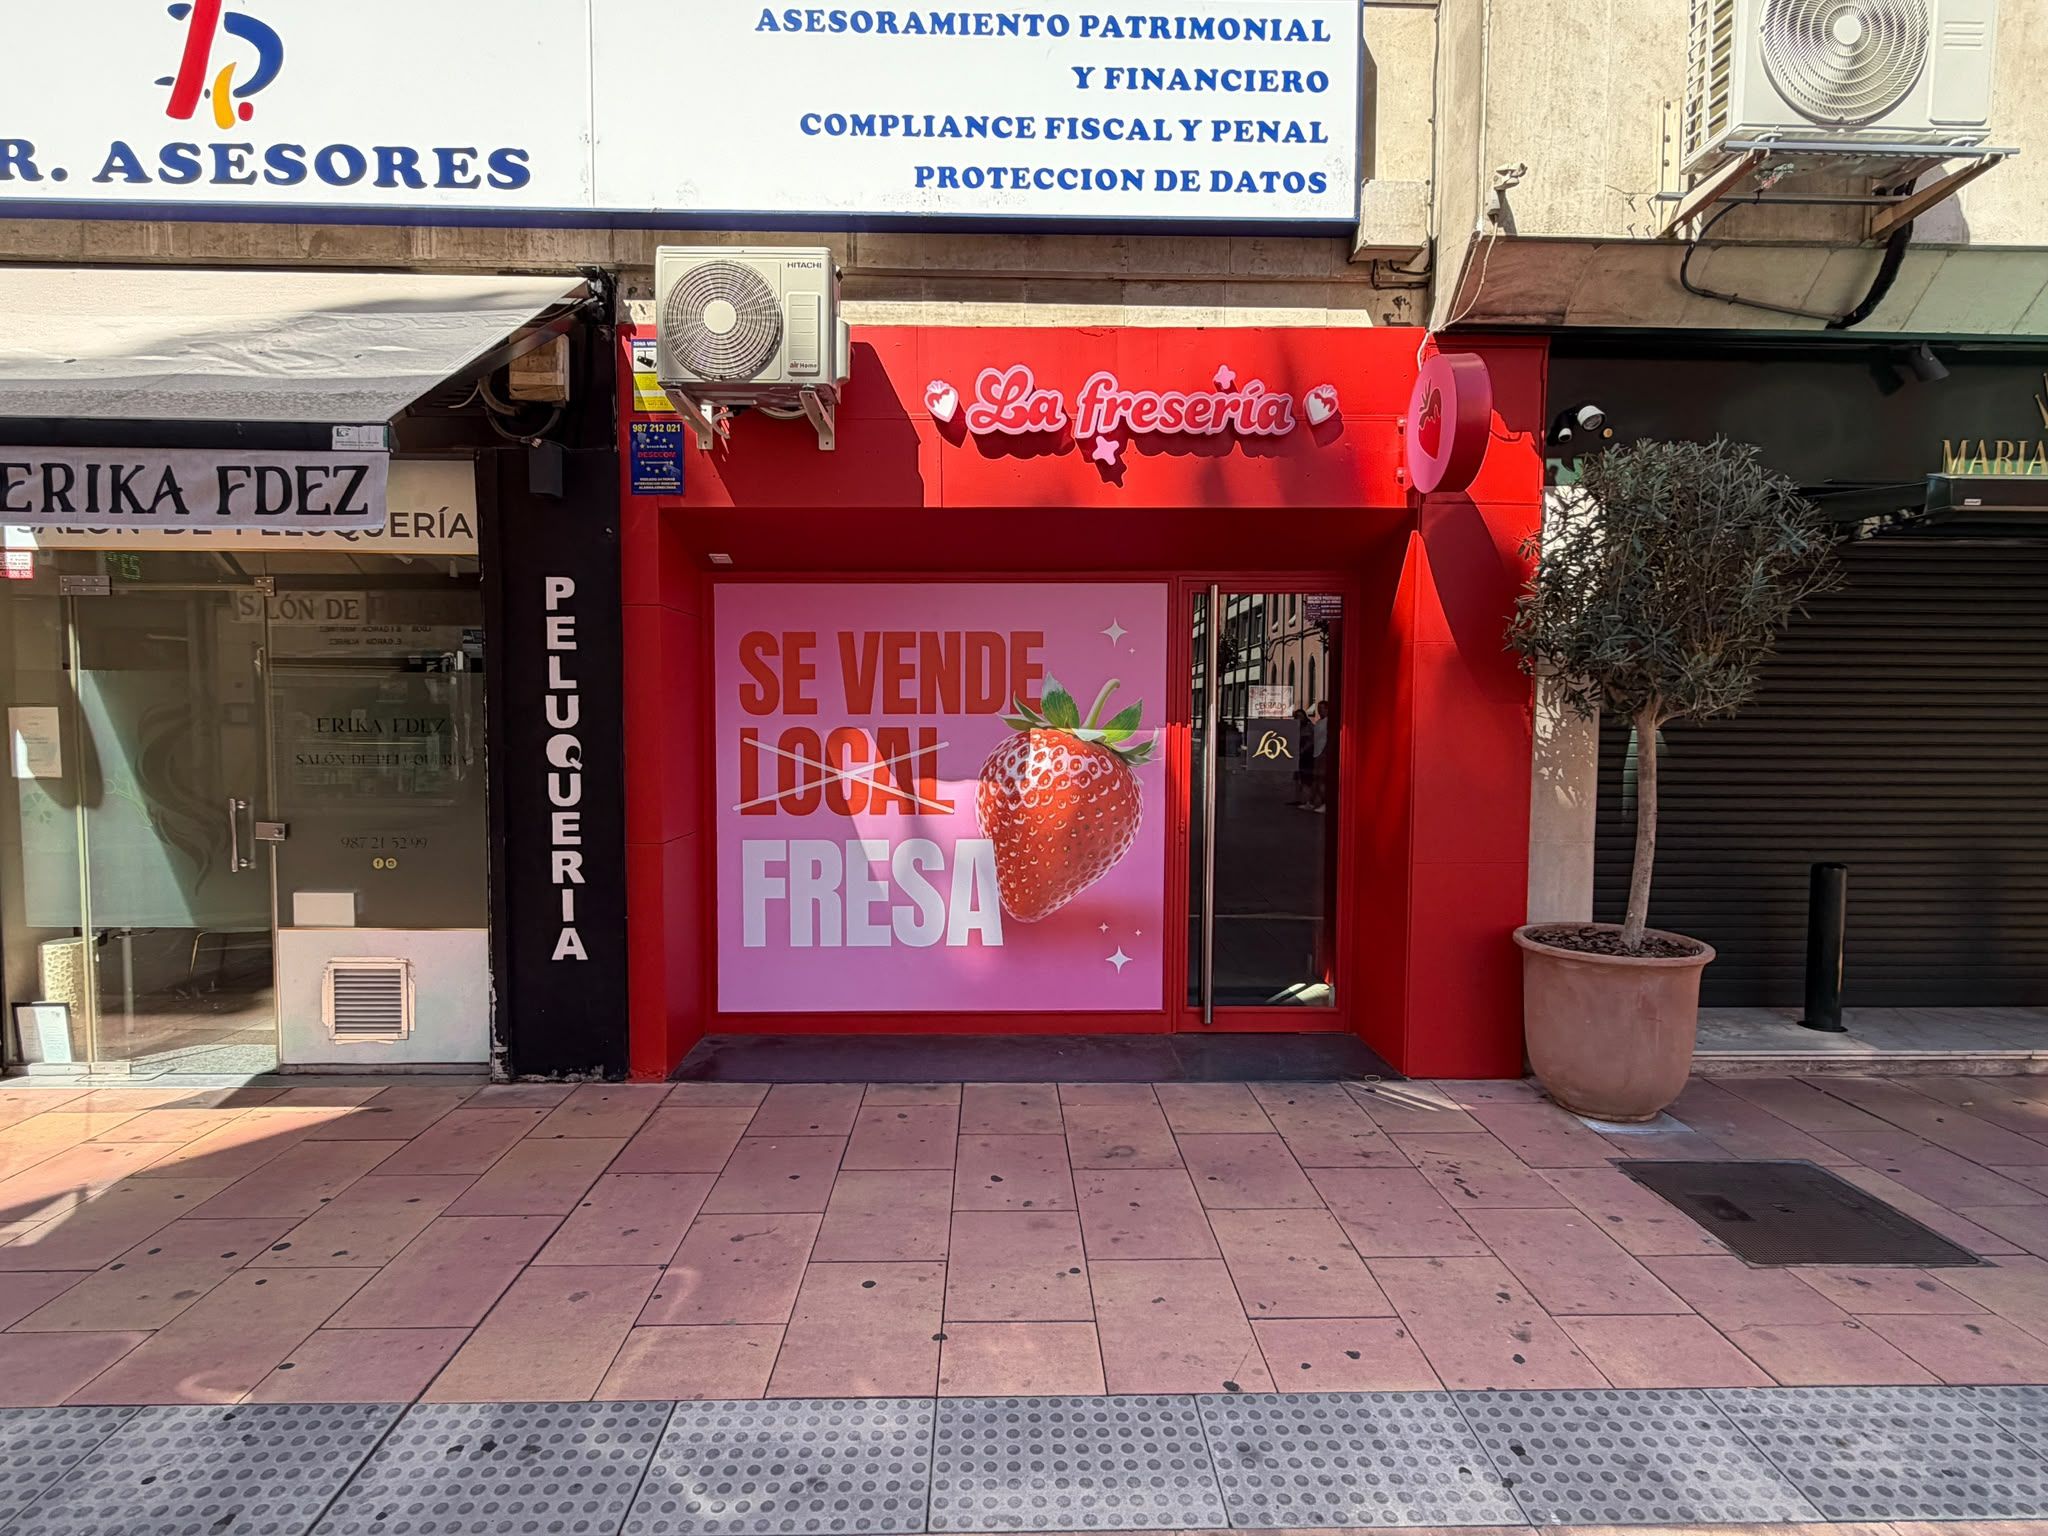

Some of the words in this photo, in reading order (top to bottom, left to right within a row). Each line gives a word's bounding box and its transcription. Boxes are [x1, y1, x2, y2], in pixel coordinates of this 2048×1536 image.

[755, 8, 1071, 38] ASESORAMIENTO
[1079, 15, 1331, 42] PATRIMONIAL
[1072, 66, 1096, 90] Y
[1104, 66, 1330, 94] FINANCIERO
[800, 112, 1036, 139] COMPLIANCE
[1044, 116, 1172, 142] FISCAL
[1179, 119, 1203, 142] Y
[1211, 120, 1328, 145] PENAL
[92, 140, 531, 190] ASESORES
[915, 165, 1145, 192] PROTECCION
[1155, 169, 1201, 193] DE
[1210, 169, 1328, 195] DATOS
[787, 261, 822, 269] HITACHI
[966, 364, 1066, 436] La
[1074, 371, 1297, 440] fresería
[632, 423, 648, 433] 987
[649, 423, 666, 433] 212
[666, 423, 681, 433] 021
[0, 462, 190, 515] ERIKA
[215, 465, 371, 516] FDEZ
[738, 630, 818, 716] SE
[837, 630, 1045, 715] VENDE
[545, 576, 589, 961] PELUQUERIA
[739, 726, 956, 817] LOCAL
[340, 836, 368, 849] 987
[371, 836, 384, 849] 21
[741, 838, 1004, 948] FRESA
